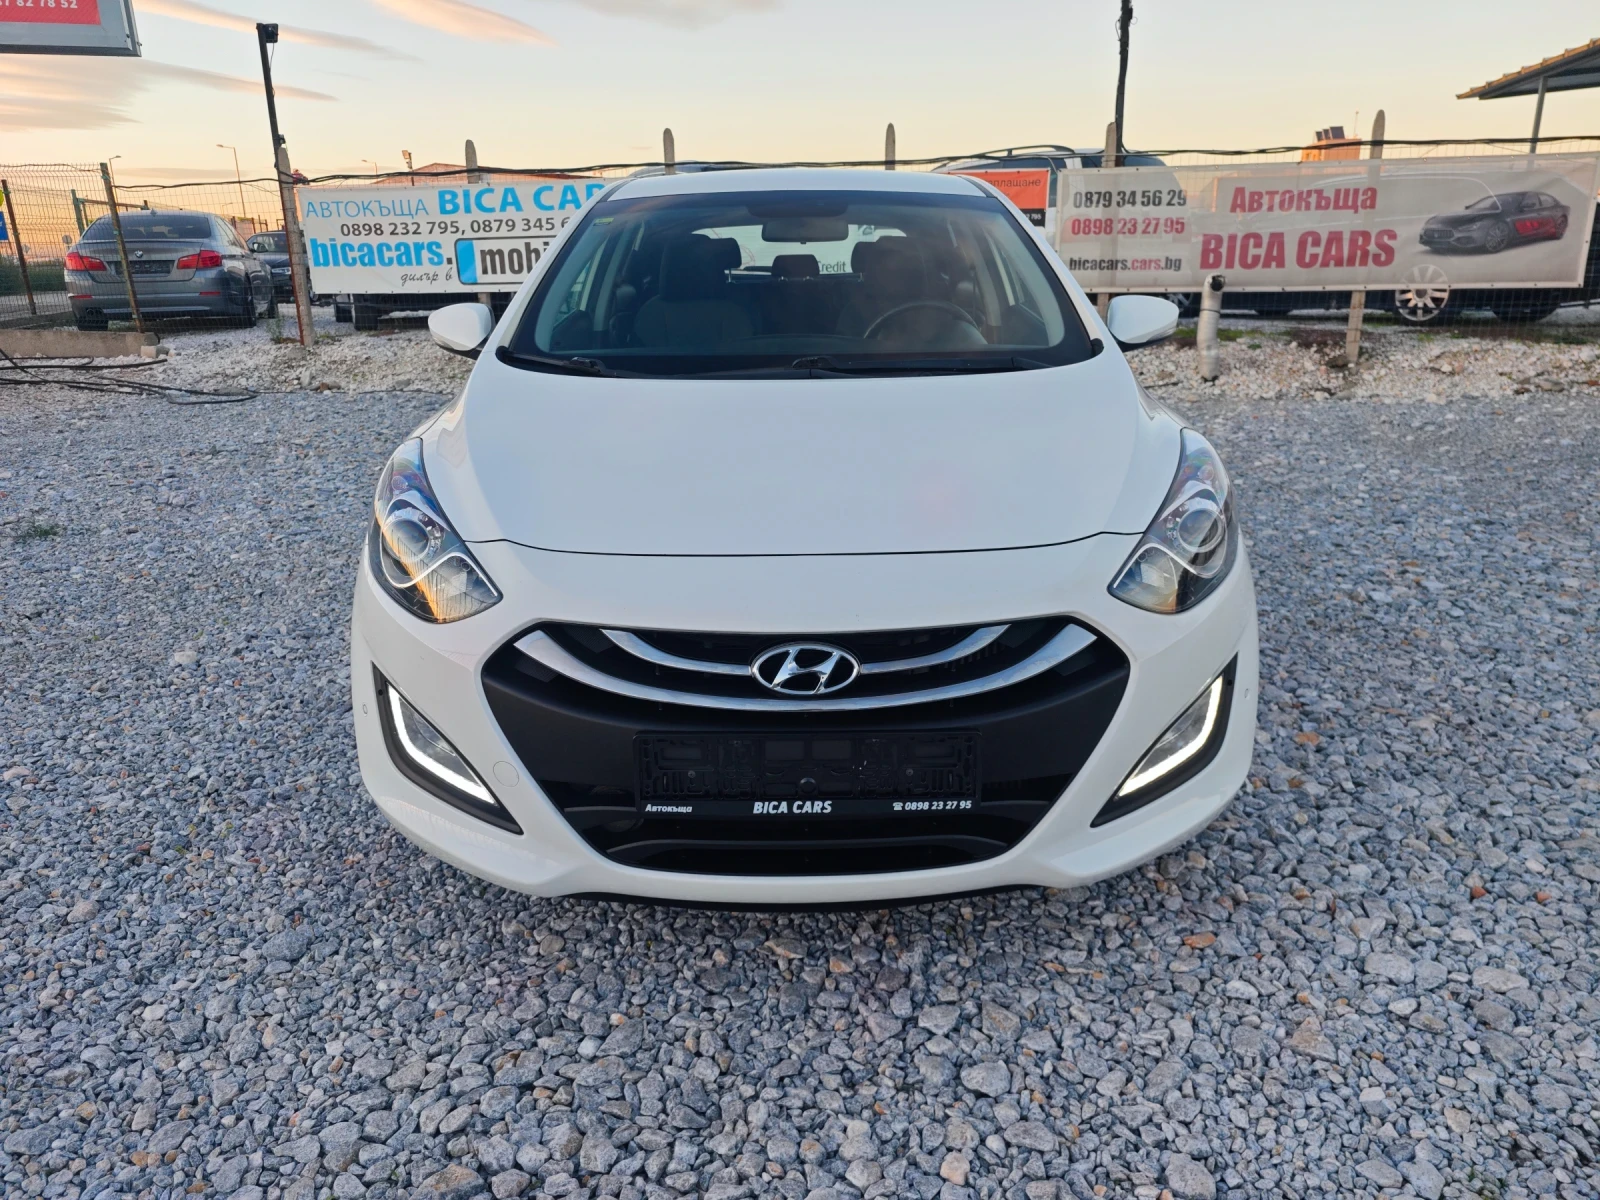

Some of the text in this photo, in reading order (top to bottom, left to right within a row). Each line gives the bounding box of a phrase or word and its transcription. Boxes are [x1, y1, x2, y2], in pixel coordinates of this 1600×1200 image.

[60, 0, 78, 9] 52
[306, 199, 429, 219] АВТОКЪЩА
[438, 187, 524, 215] BICA
[1073, 189, 1187, 208] 0879 34 56 29
[1229, 186, 1378, 214] Автокъща
[340, 223, 384, 237] 0898
[388, 222, 422, 235] 232
[426, 220, 465, 235] 795,
[470, 218, 516, 233] 0879
[521, 217, 555, 232] 345
[1071, 216, 1185, 236] 0898 23 27 95
[310, 238, 453, 267] bicacars.
[1199, 229, 1398, 270] BICA CARS
[1069, 256, 1182, 271] bicacars.cars.bg
[401, 270, 439, 287] дилър
[645, 804, 692, 813] Автокъща
[753, 800, 832, 814] BICA CARS
[904, 800, 972, 811] 0898 23 27 95
